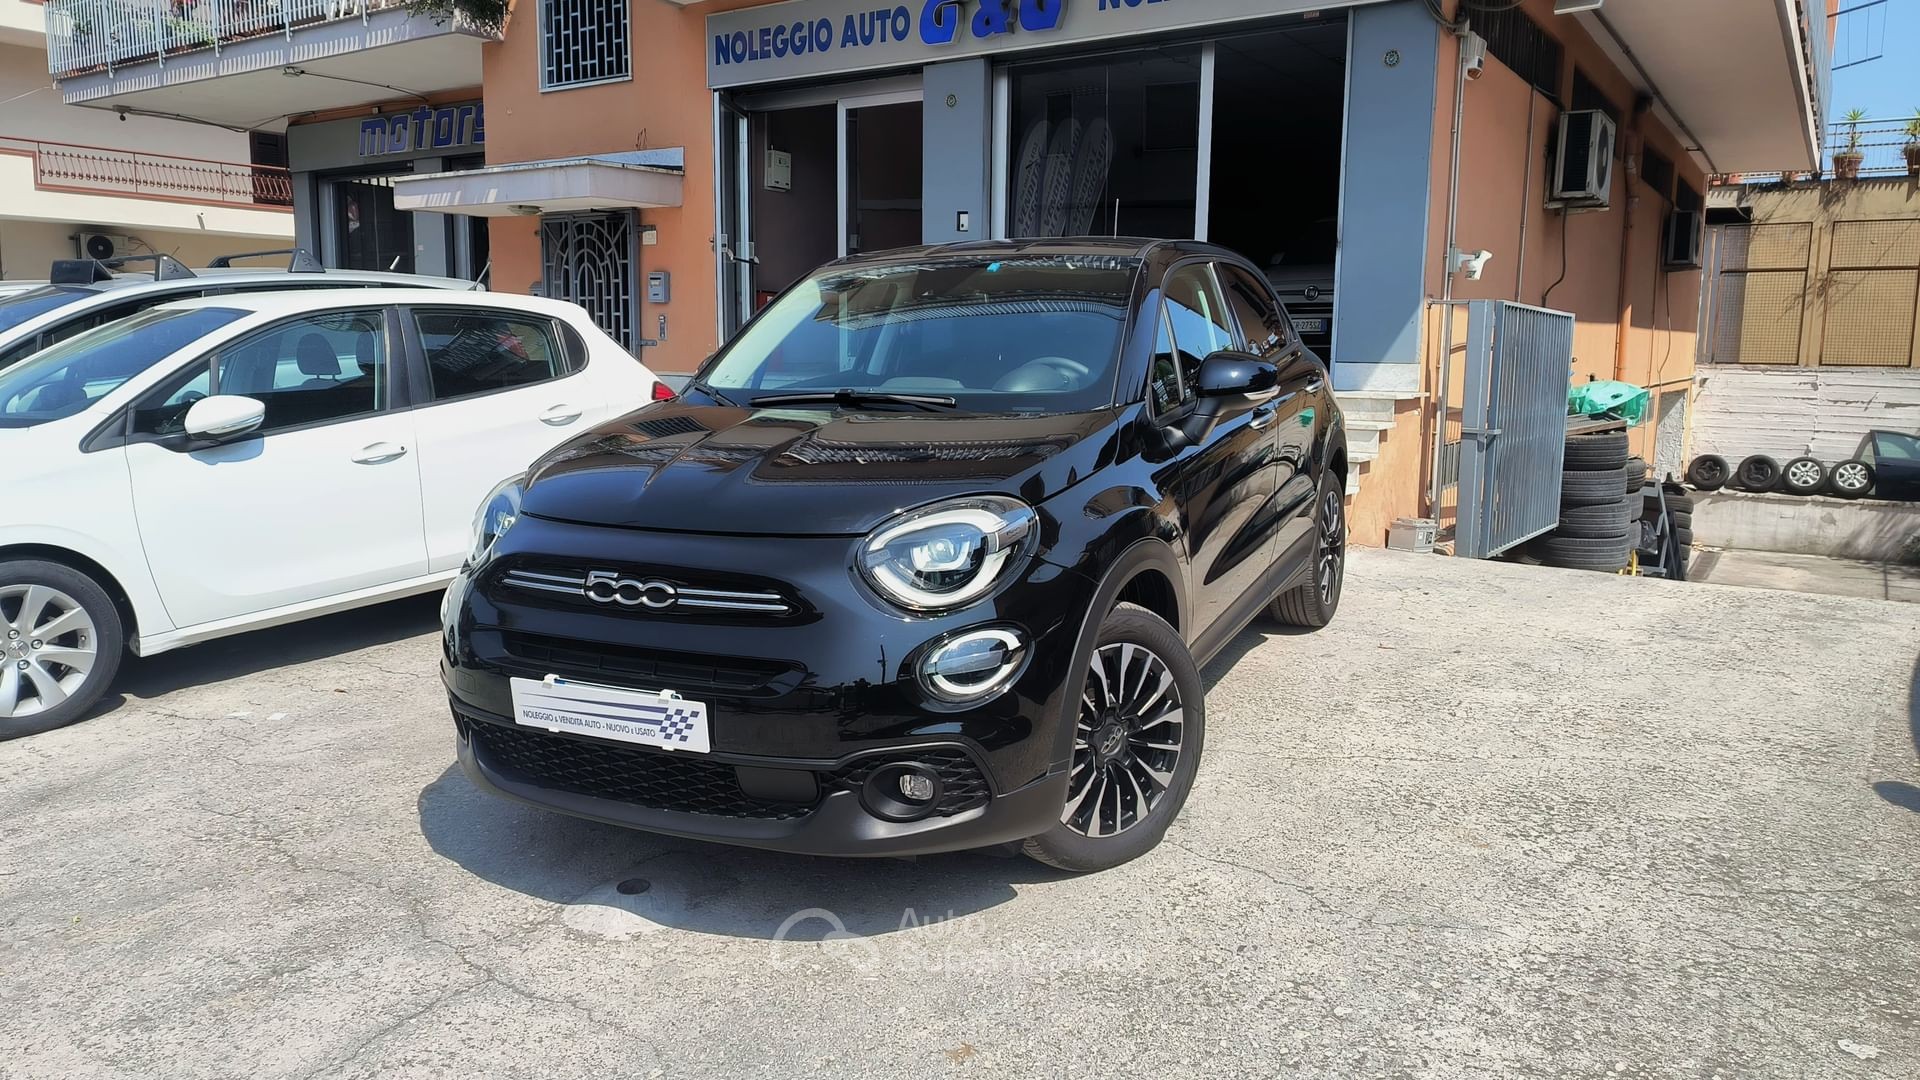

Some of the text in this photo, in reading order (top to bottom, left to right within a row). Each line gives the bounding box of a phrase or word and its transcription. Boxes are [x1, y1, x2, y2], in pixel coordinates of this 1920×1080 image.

[715, 18, 833, 65] NOLEGGIO
[840, 5, 911, 48] AUTO
[359, 105, 485, 157] motors
[584, 570, 677, 608] 500
[523, 709, 553, 722] NOLEGGIO
[558, 715, 584, 726] VENDITA
[584, 719, 601, 729] AUTO
[606, 722, 630, 734] NUOVO
[635, 726, 656, 737] USATO
